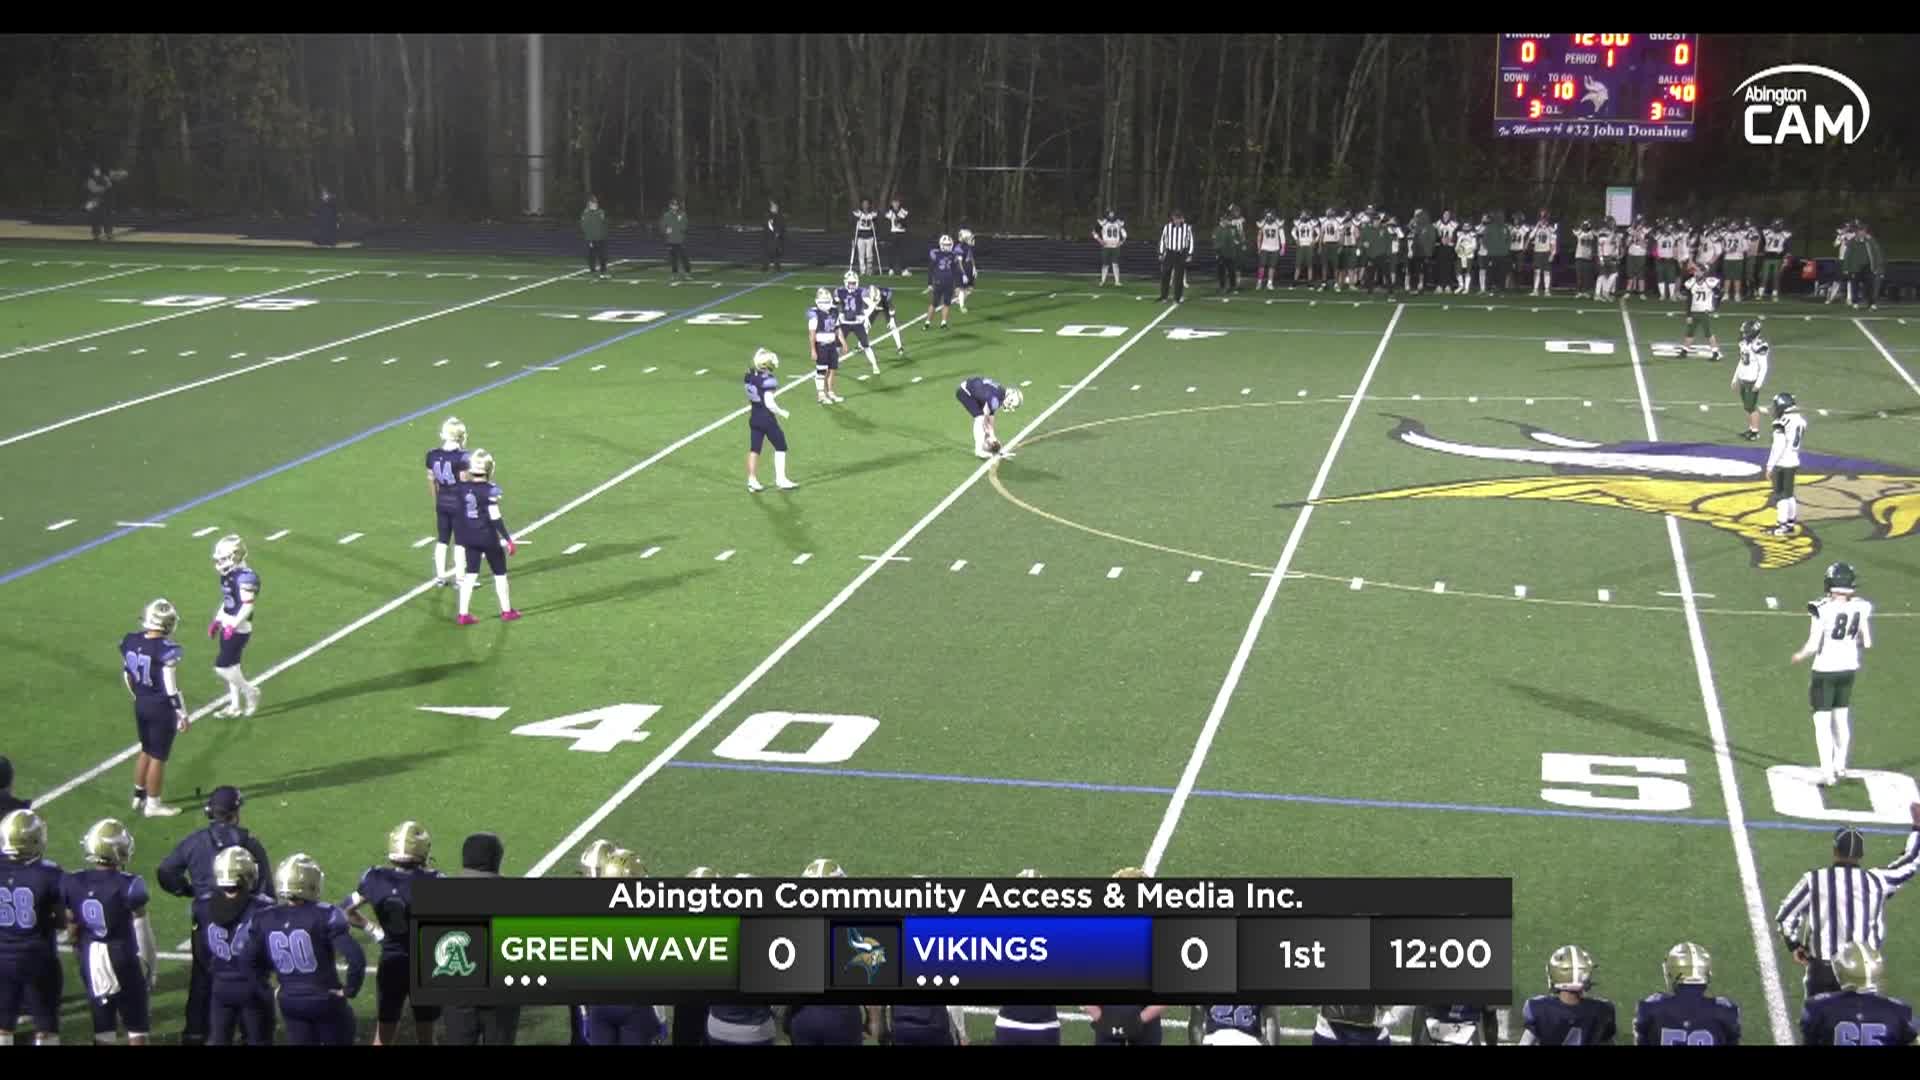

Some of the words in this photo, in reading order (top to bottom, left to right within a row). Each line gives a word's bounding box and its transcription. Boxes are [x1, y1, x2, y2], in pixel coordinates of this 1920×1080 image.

[1521, 41, 1535, 63] 0
[1565, 53, 1597, 65] PERIOD
[1607, 48, 1614, 67] 1
[1675, 43, 1689, 65] 0
[1503, 72, 1529, 82] DOWN
[1658, 75, 1679, 85] BALL
[1517, 82, 1524, 98] 1
[1529, 100, 1542, 118] 3
[1650, 102, 1663, 120] 3
[1512, 124, 1551, 135] Memory
[1553, 122, 1562, 134] of
[1566, 124, 1590, 136] #32
[1593, 124, 1624, 138] John
[1628, 124, 1688, 138] Donahue
[1695, 290, 1706, 301] 71
[432, 460, 457, 485] 44
[465, 492, 479, 519] 2
[1830, 611, 1861, 641] 84
[82, 898, 108, 939] 9
[269, 928, 318, 974] 60
